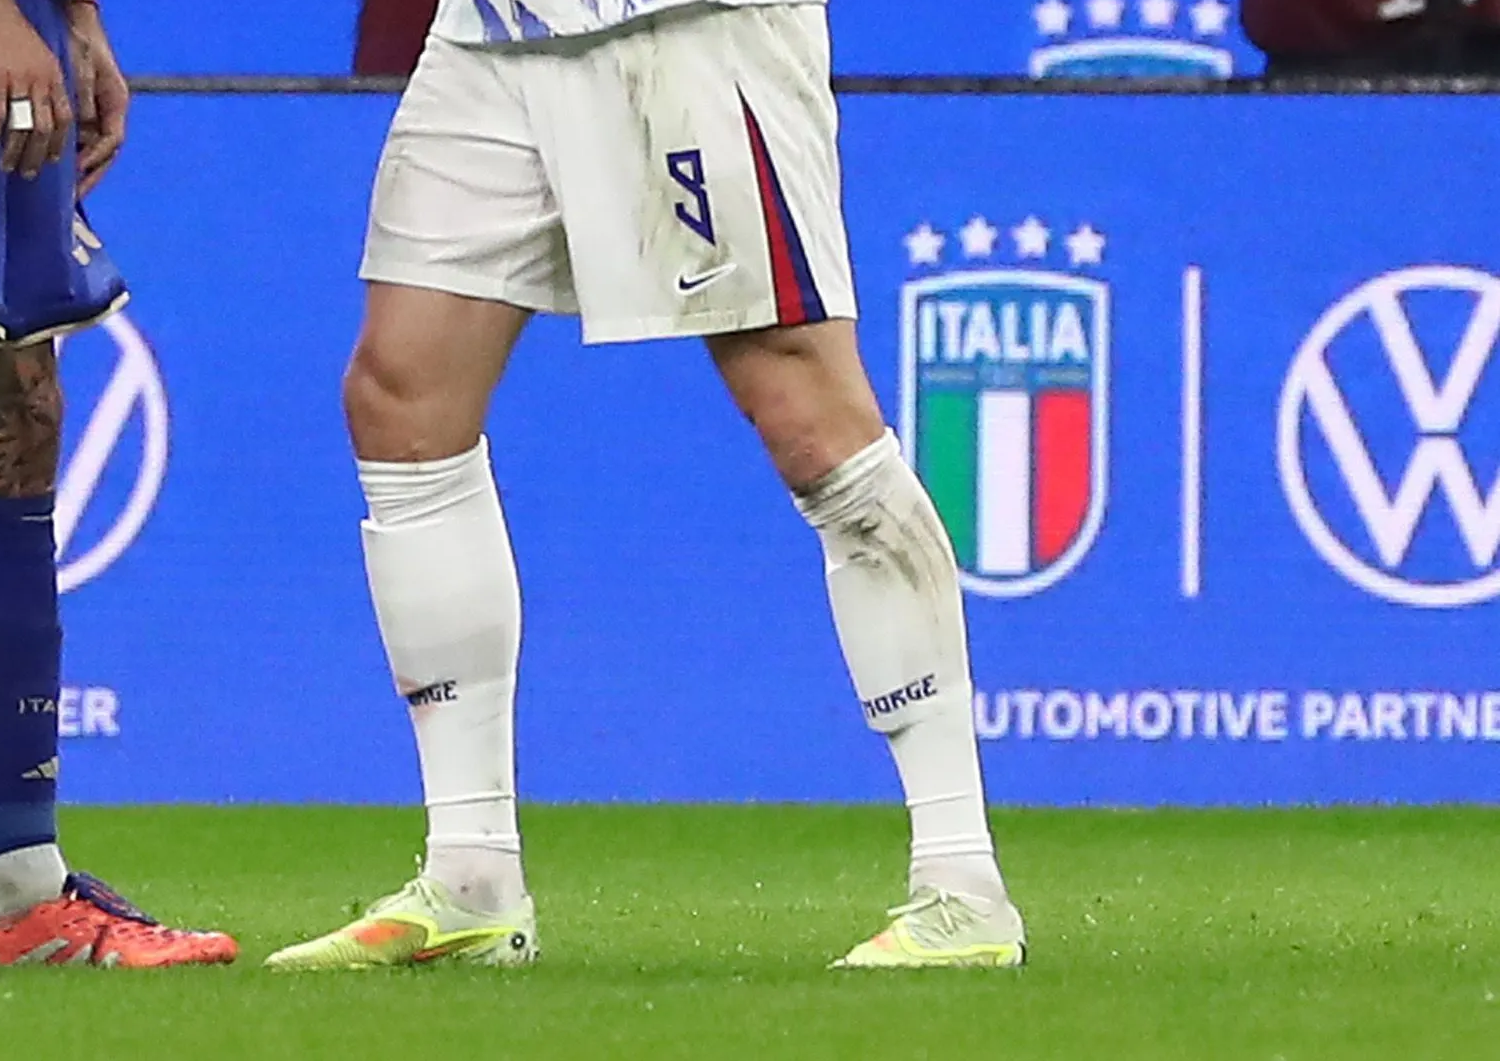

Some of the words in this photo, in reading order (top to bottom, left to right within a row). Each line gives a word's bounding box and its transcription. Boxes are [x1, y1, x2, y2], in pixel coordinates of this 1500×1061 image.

[666, 148, 717, 246] 9
[919, 301, 1089, 361] ITALIA
[974, 689, 1288, 740] UTOMOTIVE
